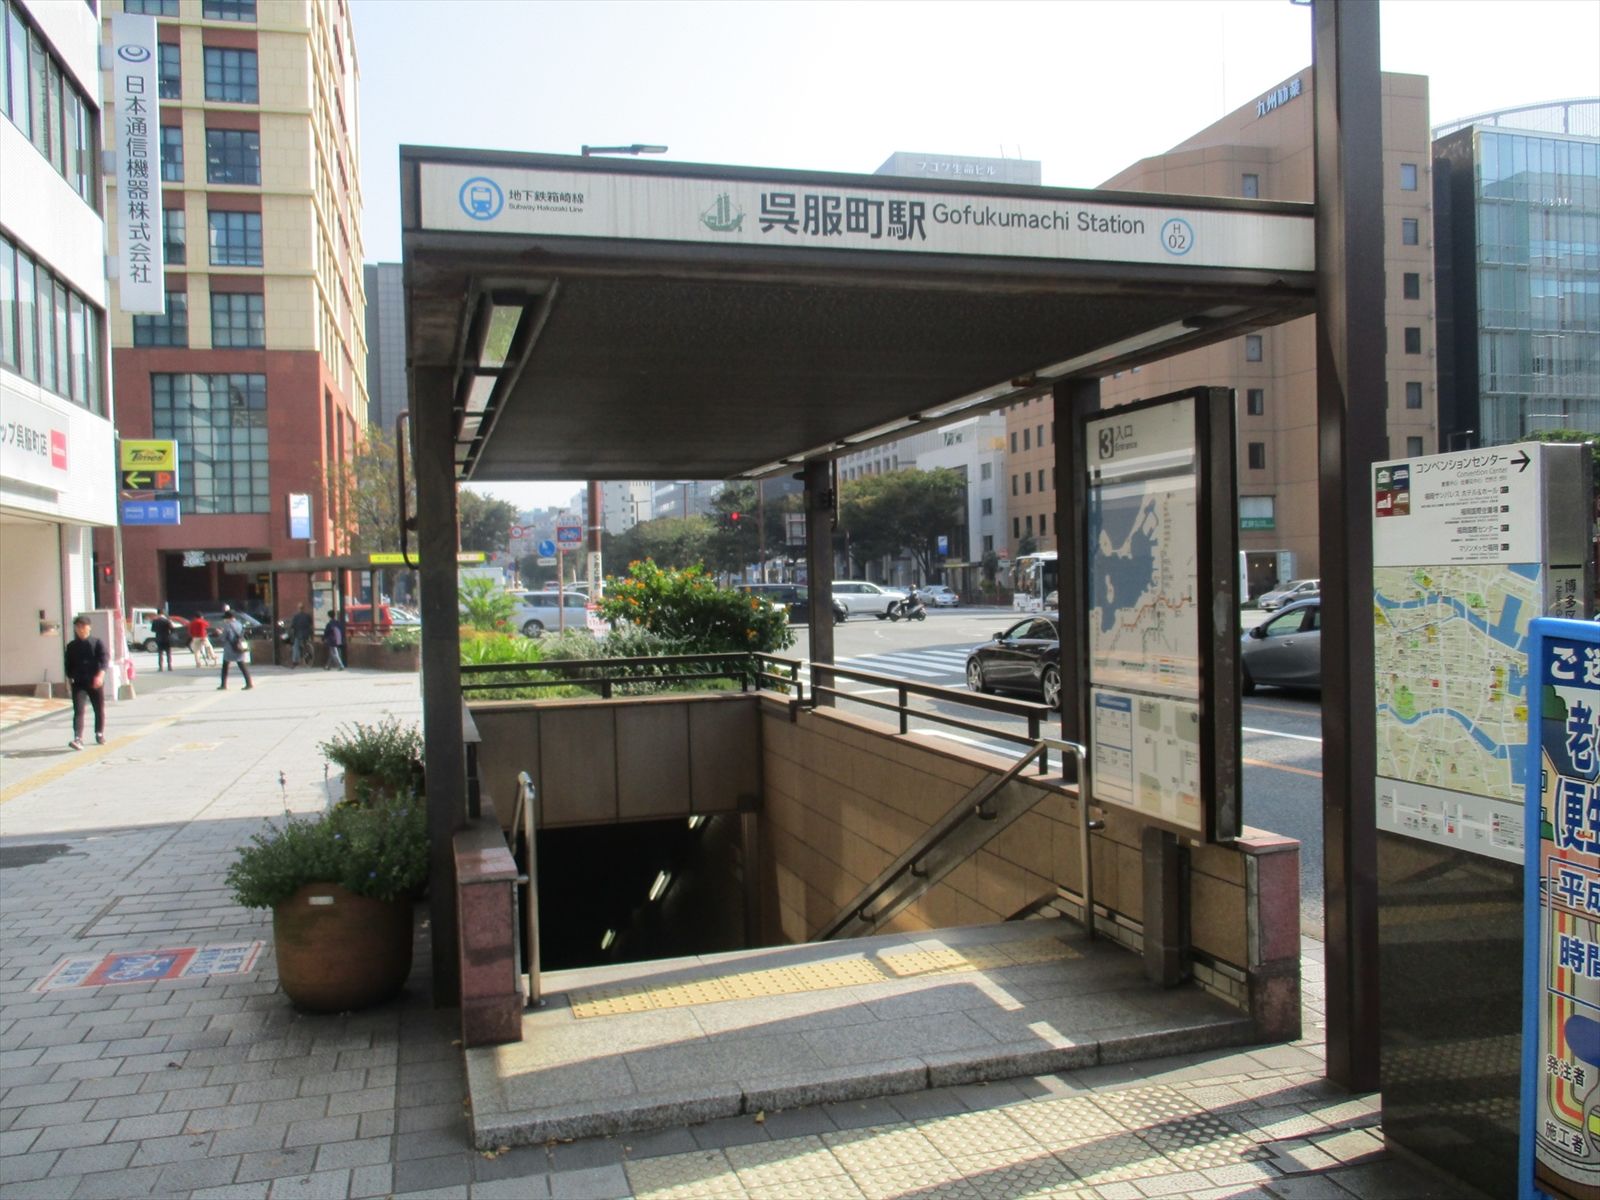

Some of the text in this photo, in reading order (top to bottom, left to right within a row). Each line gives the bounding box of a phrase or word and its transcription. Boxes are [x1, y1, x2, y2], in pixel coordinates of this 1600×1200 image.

[125, 75, 152, 284] 日本通信機器株式会社
[509, 189, 584, 204] 地下鉄箱崎線
[509, 202, 536, 212] Subway
[536, 204, 568, 213] Hakozaki
[759, 193, 926, 241] 呉服町駅
[932, 203, 1145, 235] Gofukumachi Station
[1173, 223, 1182, 234] H
[1168, 234, 1186, 249] 02
[1115, 424, 1133, 441] 入口
[1100, 428, 1114, 459] 3
[1114, 441, 1138, 452] Entrance
[1416, 454, 1509, 474] コンベンションセンター
[1456, 467, 1508, 478] Convention Center
[1547, 1055, 1585, 1087] 発注者
[1545, 1120, 1584, 1154] 施工者
